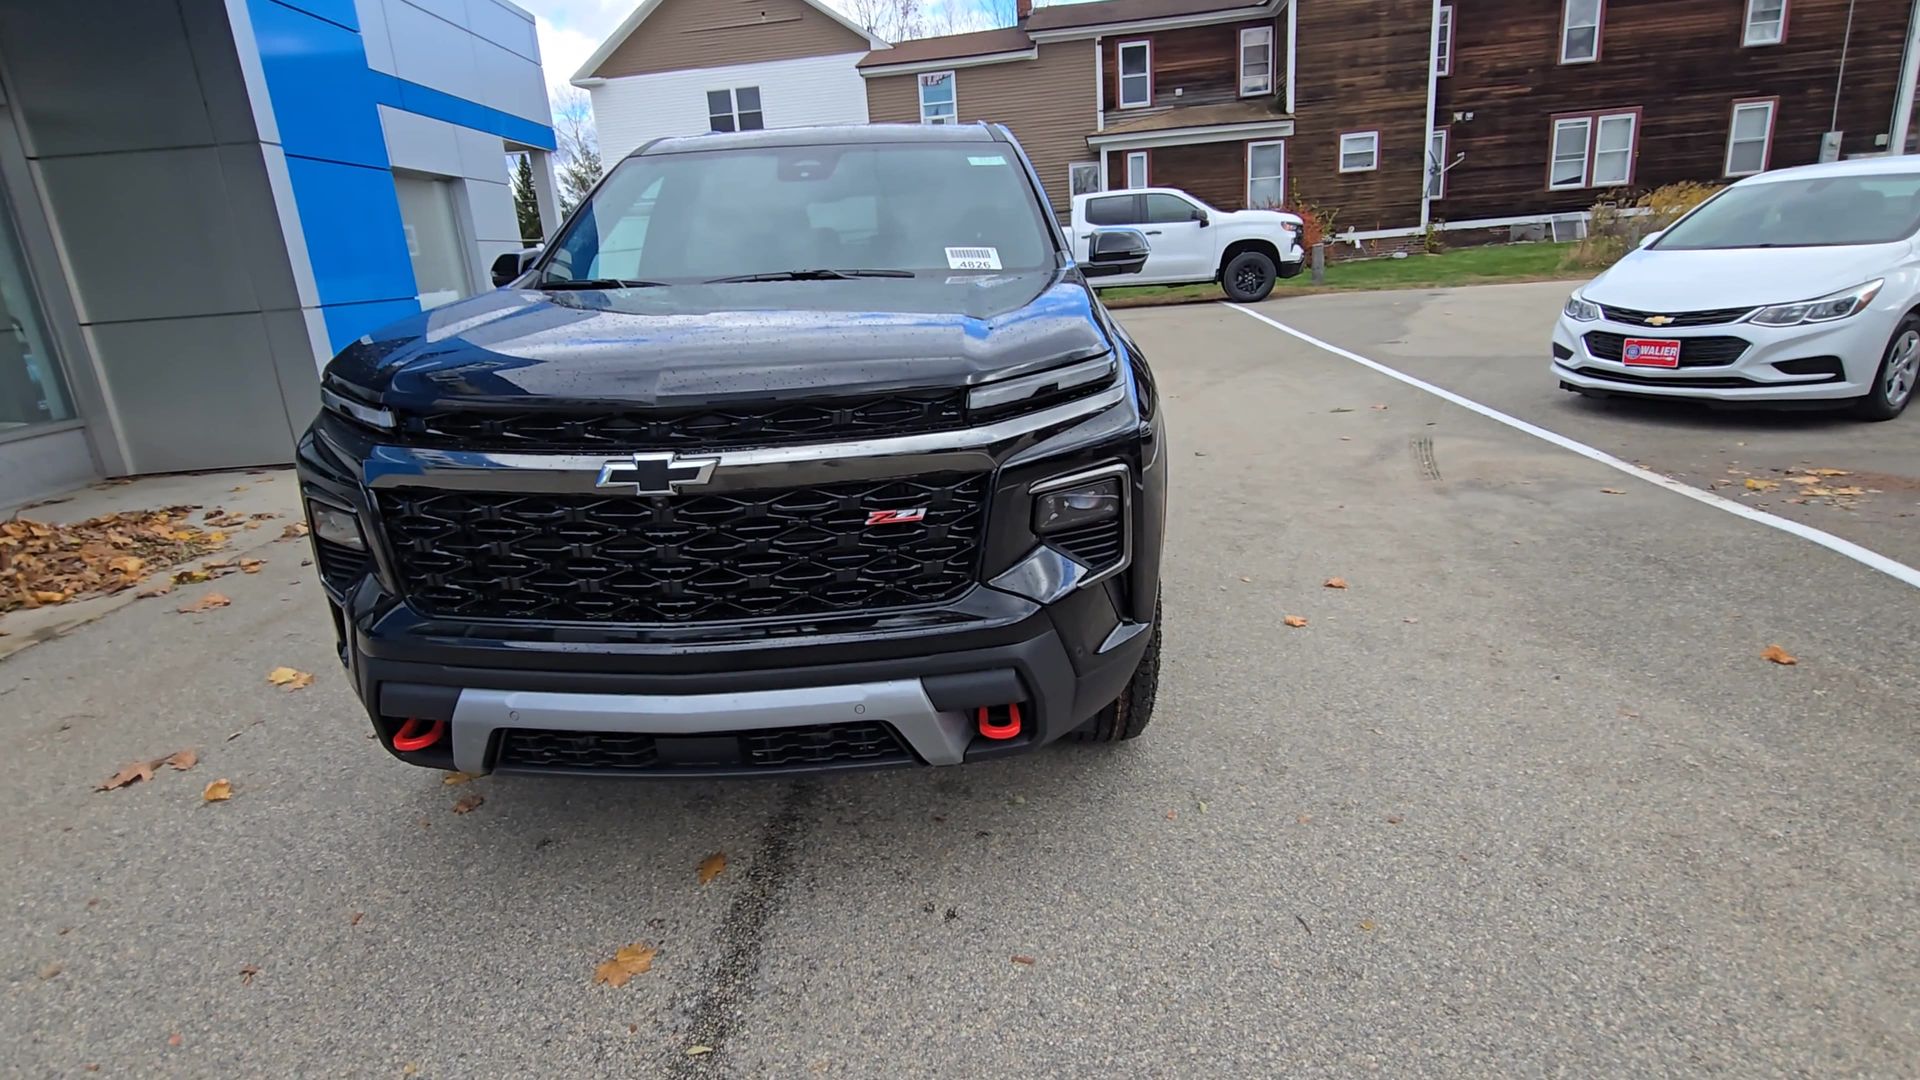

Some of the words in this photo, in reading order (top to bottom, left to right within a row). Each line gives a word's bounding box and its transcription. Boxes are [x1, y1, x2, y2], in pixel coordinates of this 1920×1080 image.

[960, 261, 991, 269] 4826
[1640, 345, 1678, 356] WALIER
[865, 508, 927, 525] Z71
